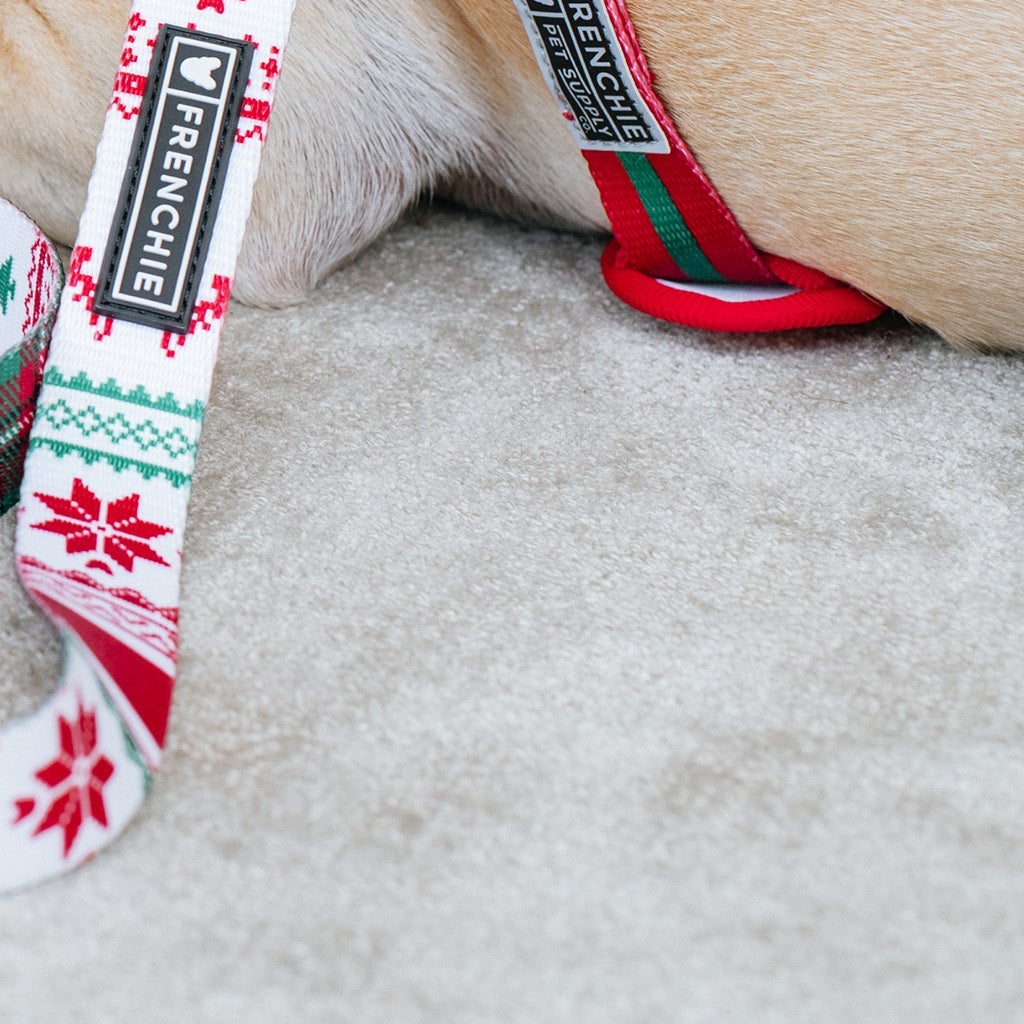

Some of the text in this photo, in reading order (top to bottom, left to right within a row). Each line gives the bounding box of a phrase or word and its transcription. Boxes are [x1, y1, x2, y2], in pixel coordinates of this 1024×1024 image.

[541, 23, 614, 138] PET SUPPLY
[577, 113, 592, 134] CO.
[133, 102, 205, 296] FRENCHIE
